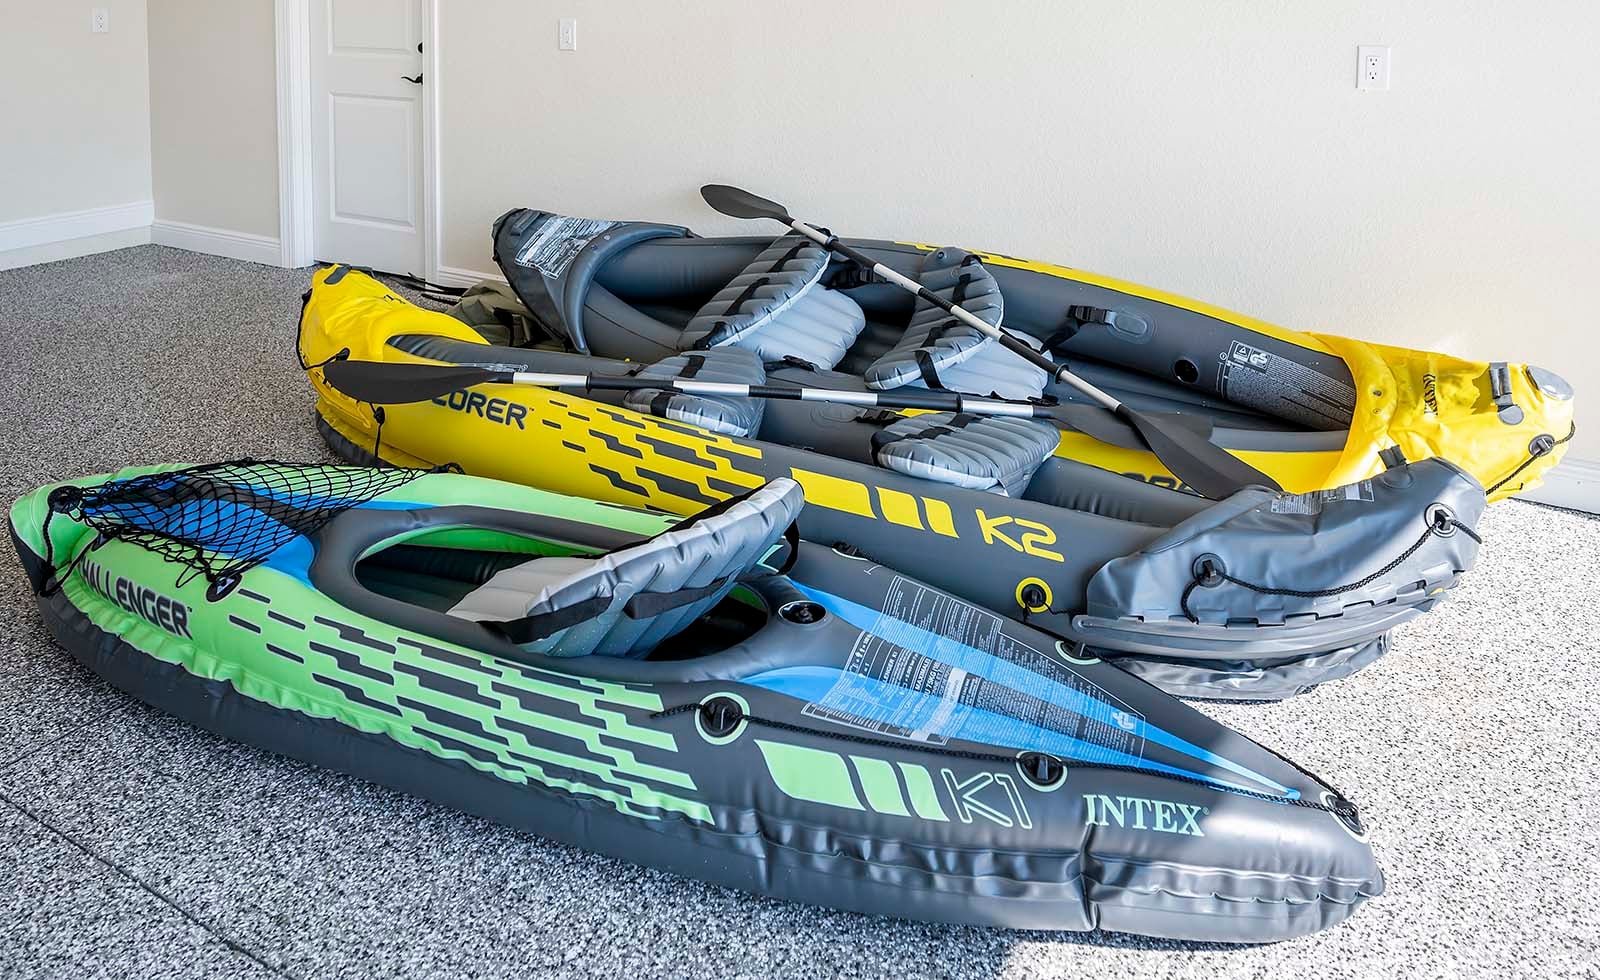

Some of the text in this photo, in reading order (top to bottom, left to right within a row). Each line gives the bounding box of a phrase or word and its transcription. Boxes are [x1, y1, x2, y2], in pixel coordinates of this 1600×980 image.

[975, 508, 1065, 563] K2
[80, 554, 194, 641] HALLENGER
[940, 767, 1033, 830] K1
[1082, 794, 1206, 838] INTEX
